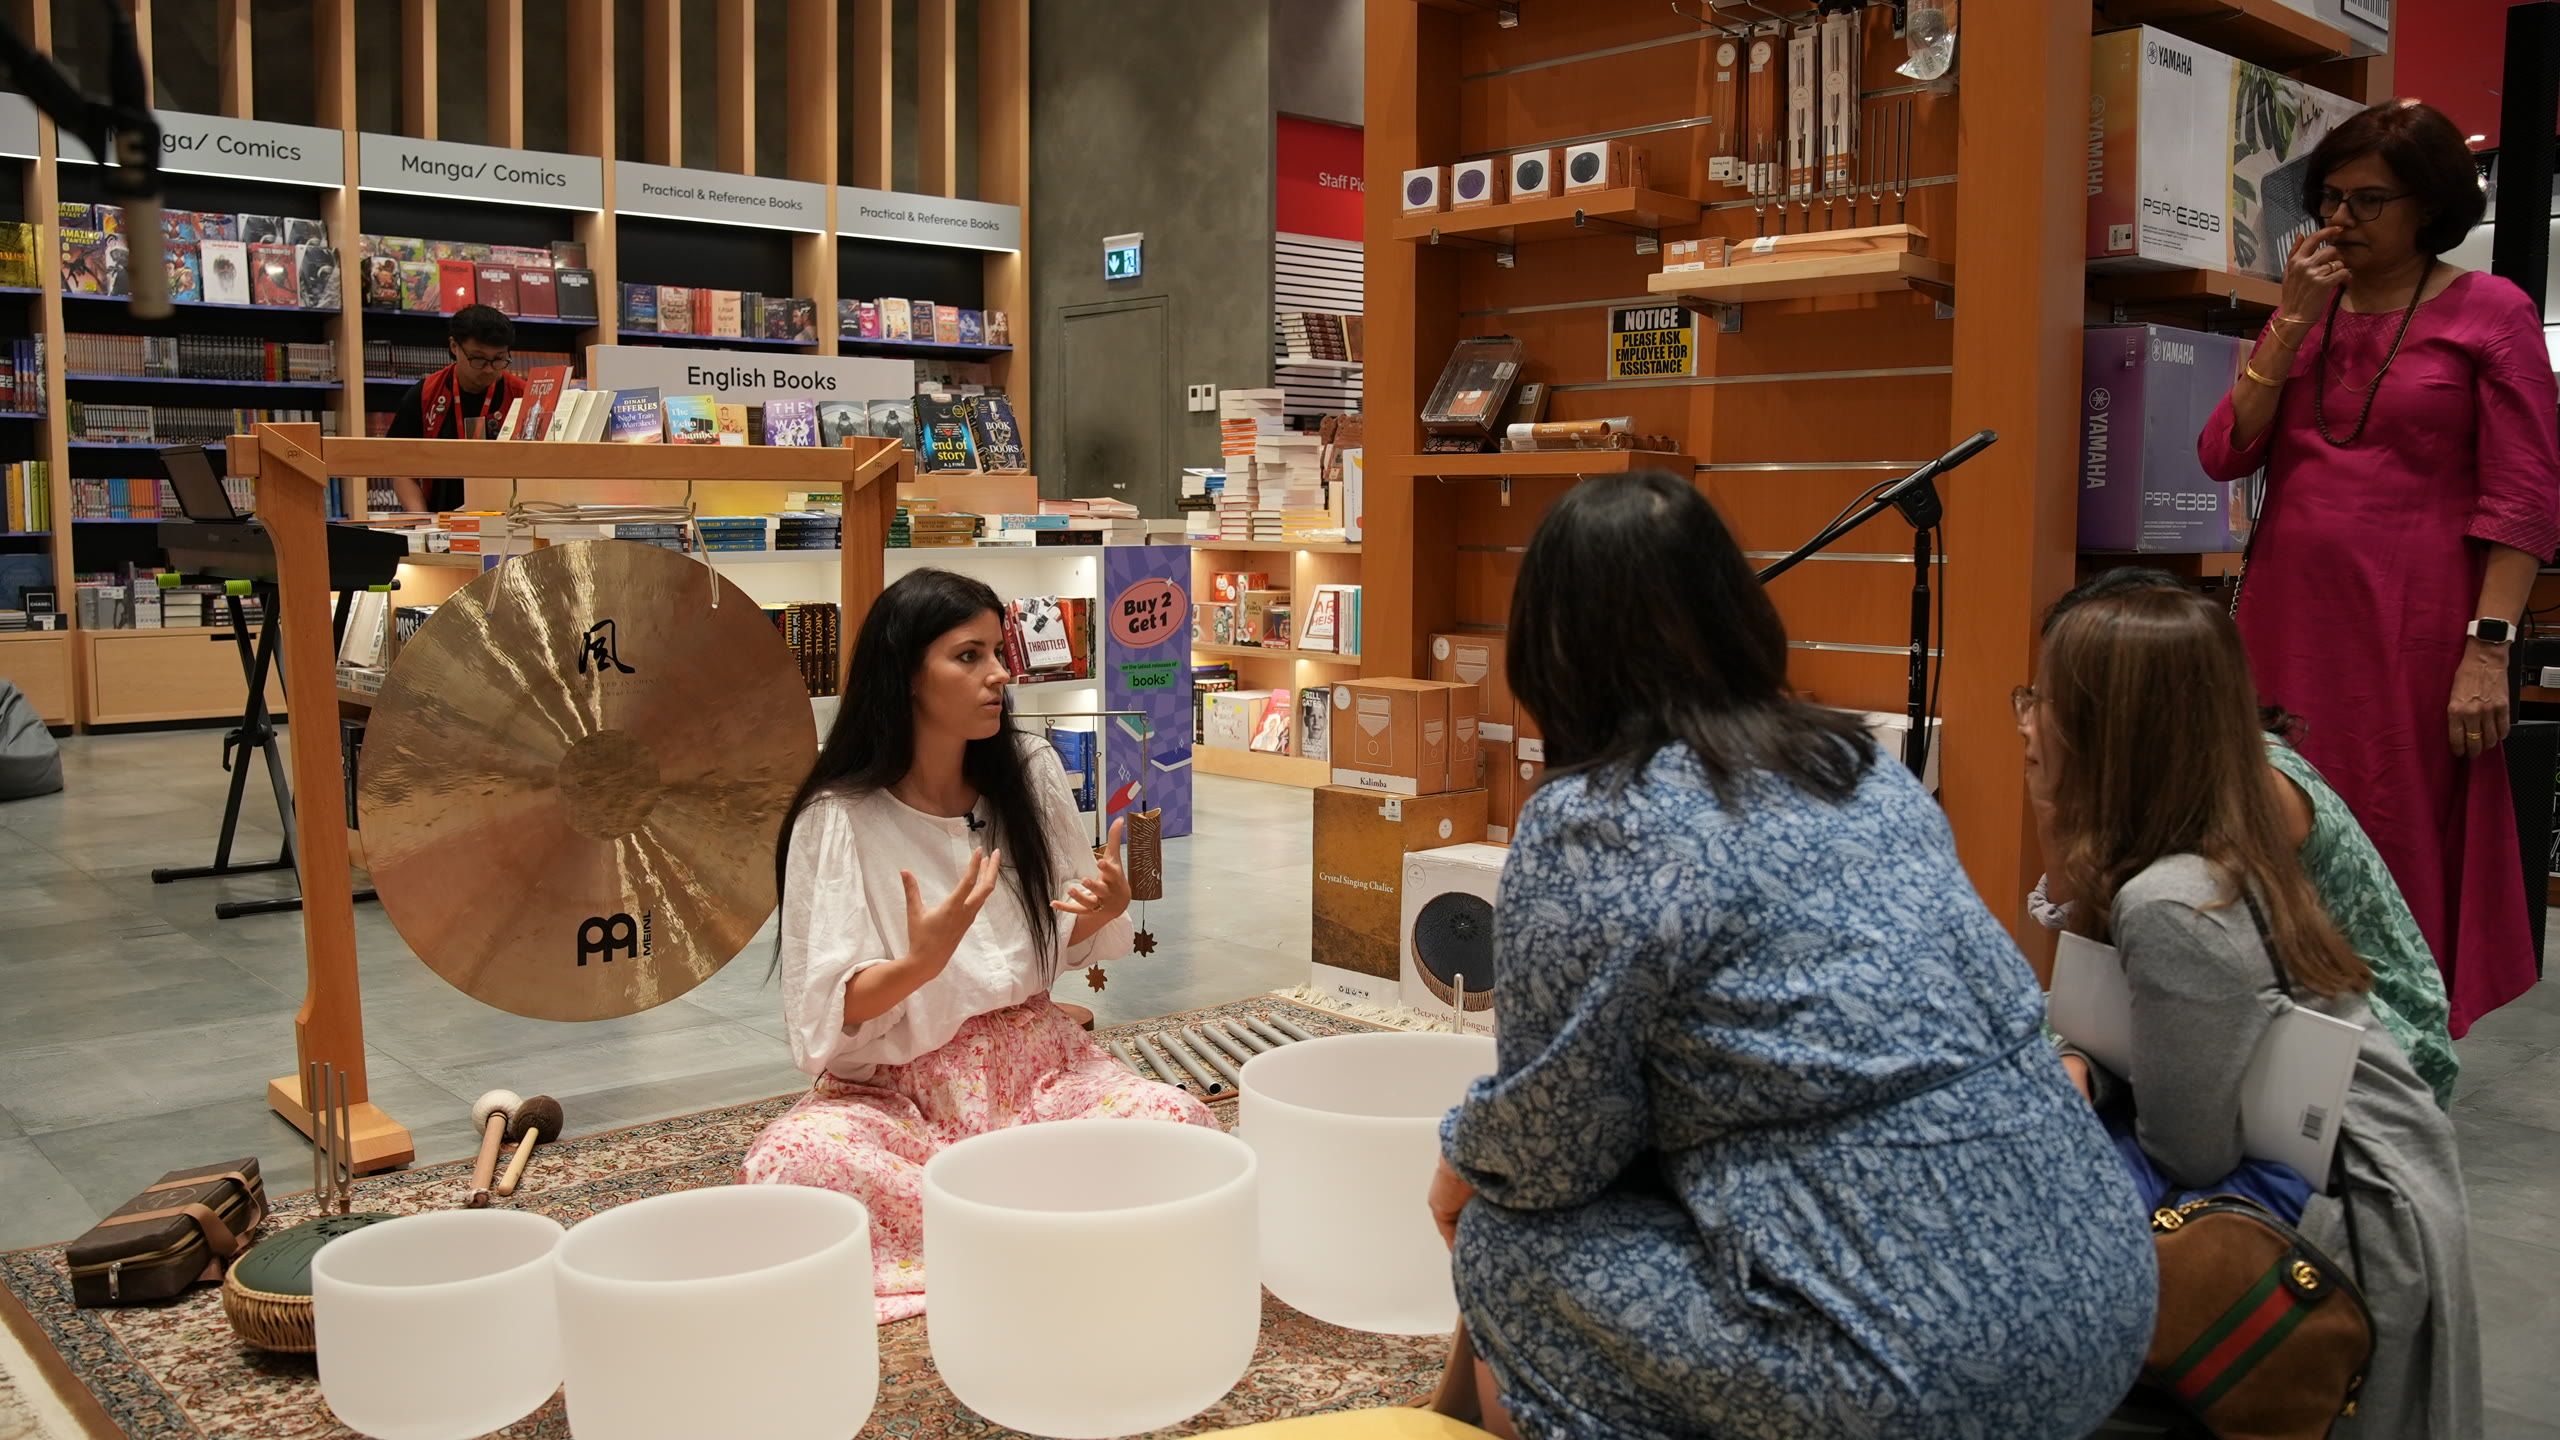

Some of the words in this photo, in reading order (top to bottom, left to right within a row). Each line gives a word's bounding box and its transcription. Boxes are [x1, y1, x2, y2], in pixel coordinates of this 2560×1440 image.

[2158, 45, 2193, 77] YAMAHA
[216, 134, 302, 162] Comics
[2087, 116, 2104, 197] YAMAHA
[401, 153, 487, 182] Manga/
[494, 164, 567, 187] Comics
[1319, 171, 1347, 190] Staff
[642, 183, 695, 200] Practical
[696, 188, 705, 199] &
[708, 190, 766, 207] Reference
[769, 196, 803, 211] Books
[860, 206, 904, 222] Practical
[907, 211, 915, 222] &
[917, 212, 968, 228] Reference
[970, 217, 1000, 232] Books
[2143, 197, 2220, 233] PSR-E283
[1625, 307, 1679, 331] NOTICE
[1622, 332, 1658, 348] PLEASE
[1659, 331, 1681, 345] ASK
[1616, 346, 1666, 362] EMPLOYEE
[1668, 345, 1688, 359] FOR
[2161, 341, 2194, 365] YAMAHA
[1619, 359, 1683, 376] ASSISTANCE
[687, 365, 766, 391] English
[773, 370, 837, 391] Books
[613, 402, 657, 414] JEFFERIES
[672, 408, 689, 416] The
[773, 401, 807, 414] THE
[617, 414, 636, 423] Night
[638, 412, 654, 420] Train
[622, 419, 657, 429] Marrakech
[673, 419, 697, 429] Echo
[775, 418, 807, 431] WAY
[985, 421, 1011, 430] BOOK
[674, 431, 716, 441] Chamber
[931, 438, 952, 450] end
[955, 437, 968, 450] of
[937, 451, 966, 463] story
[989, 444, 1019, 453] DOORS
[2086, 412, 2108, 489] YAMAHA
[2144, 491, 2217, 512] PSR-E383
[1003, 515, 1037, 523] DEATH'S
[1124, 597, 1157, 617] Buy
[1161, 591, 1172, 608] 2
[1128, 614, 1157, 634] Get
[1160, 611, 1168, 627] 1
[1027, 638, 1066, 653] THROTTLED
[1302, 699, 1321, 708] GATES
[1305, 691, 1321, 700] BILL
[1360, 776, 1387, 788] Kalimba
[1319, 872, 1342, 884] Crystal
[1343, 874, 1368, 890] Singing
[1369, 881, 1394, 894] Chalice
[643, 909, 652, 956] MEINL
[1413, 1006, 1439, 1020] Octave
[1463, 1018, 1490, 1034] Tongue
